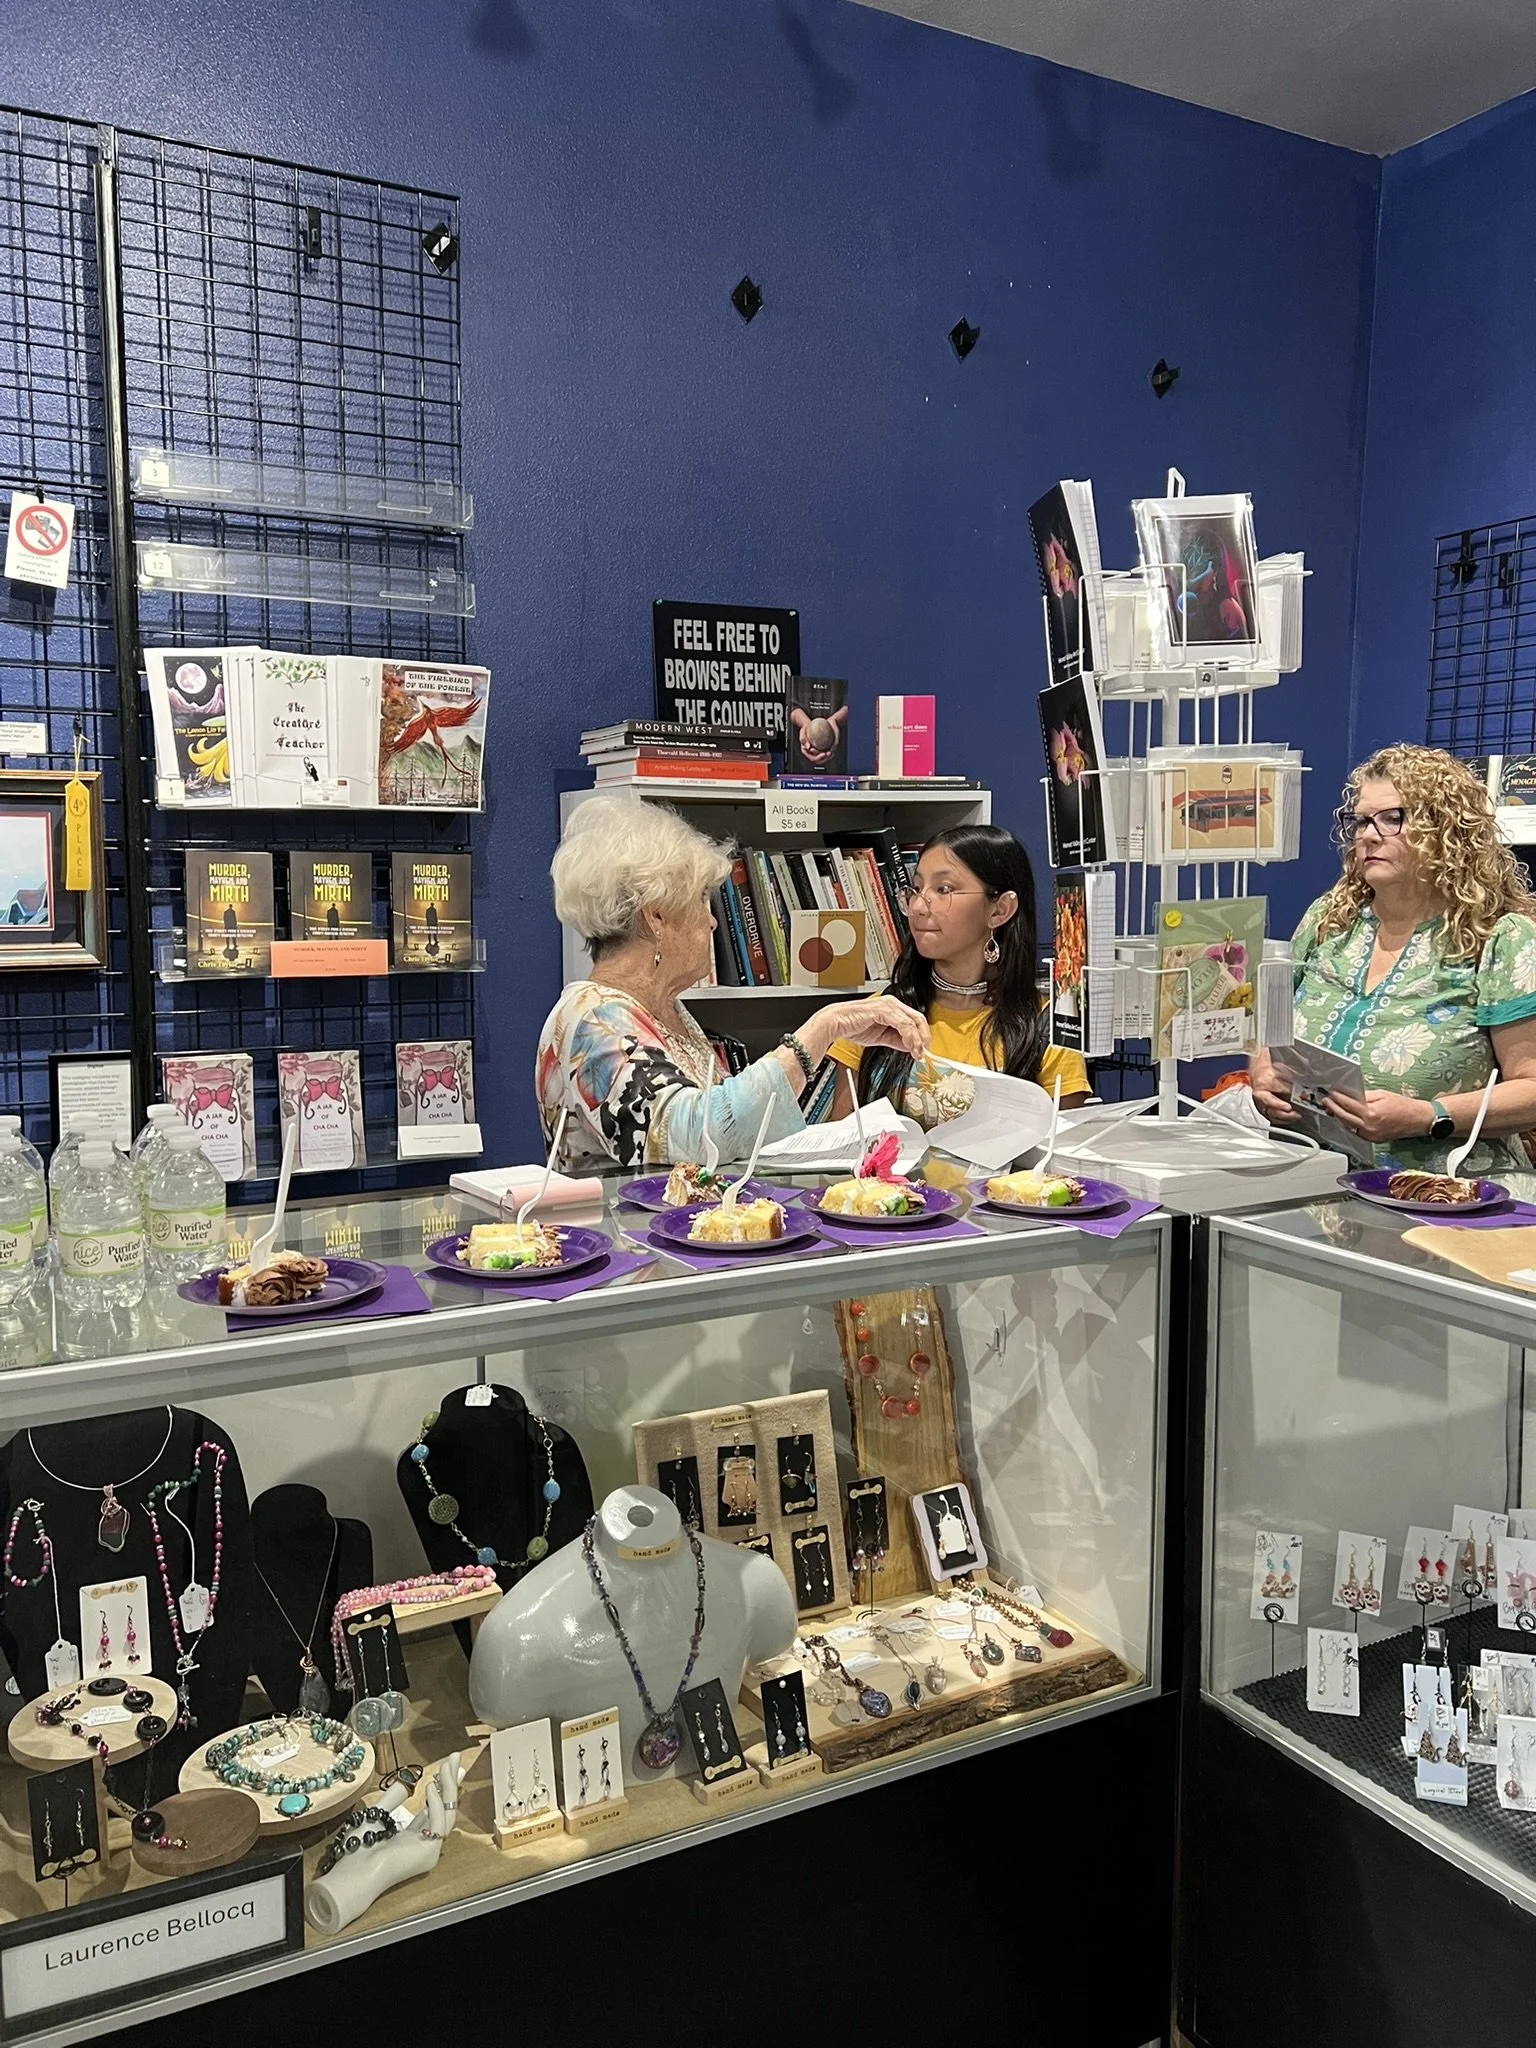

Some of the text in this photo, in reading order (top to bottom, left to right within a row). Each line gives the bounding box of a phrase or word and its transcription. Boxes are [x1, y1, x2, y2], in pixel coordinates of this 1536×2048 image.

[152, 468, 158, 477] 3
[153, 561, 165, 570] 12
[674, 618, 780, 655] FEEL FREE TO
[427, 675, 470, 684] FIREBIRD
[664, 658, 792, 693] BROWSE BEHIND
[437, 685, 472, 693] FOREST
[284, 702, 306, 713] The
[675, 698, 785, 732] THE COUNTER
[273, 717, 322, 730] Creature
[635, 722, 682, 733] MODERN
[685, 726, 713, 735] WEST
[772, 804, 815, 816] All Books
[781, 819, 807, 829] $5 ea
[75, 822, 83, 878] PLACE
[208, 863, 251, 879] MURDER,
[313, 863, 353, 879] MURDER,
[412, 864, 451, 879] MURDER,
[838, 864, 846, 877] THE
[891, 842, 908, 887] THE ART
[236, 877, 248, 885] AND
[338, 876, 350, 885] AND
[437, 877, 448, 885] AND
[210, 885, 249, 902] MIRTH
[314, 884, 351, 902] MIRTH
[413, 885, 449, 901] MIRTH
[742, 895, 764, 958] OVERDRIVE
[212, 1112, 223, 1120] JAR
[174, 1219, 212, 1233] Purified
[0, 1237, 18, 1250] fied
[179, 1231, 210, 1242] Water
[73, 1243, 101, 1261] nice
[108, 1239, 141, 1256] Purified
[0, 1250, 15, 1261] ter
[113, 1251, 140, 1264] Water
[656, 1546, 671, 1554] made
[571, 1716, 610, 1733] hand made
[782, 1765, 816, 1782] hand made
[718, 1779, 753, 1797] hand made
[580, 1810, 620, 1827] hand made
[514, 1823, 555, 1839] hand made
[45, 1900, 255, 1971] Laurence Bellocq
